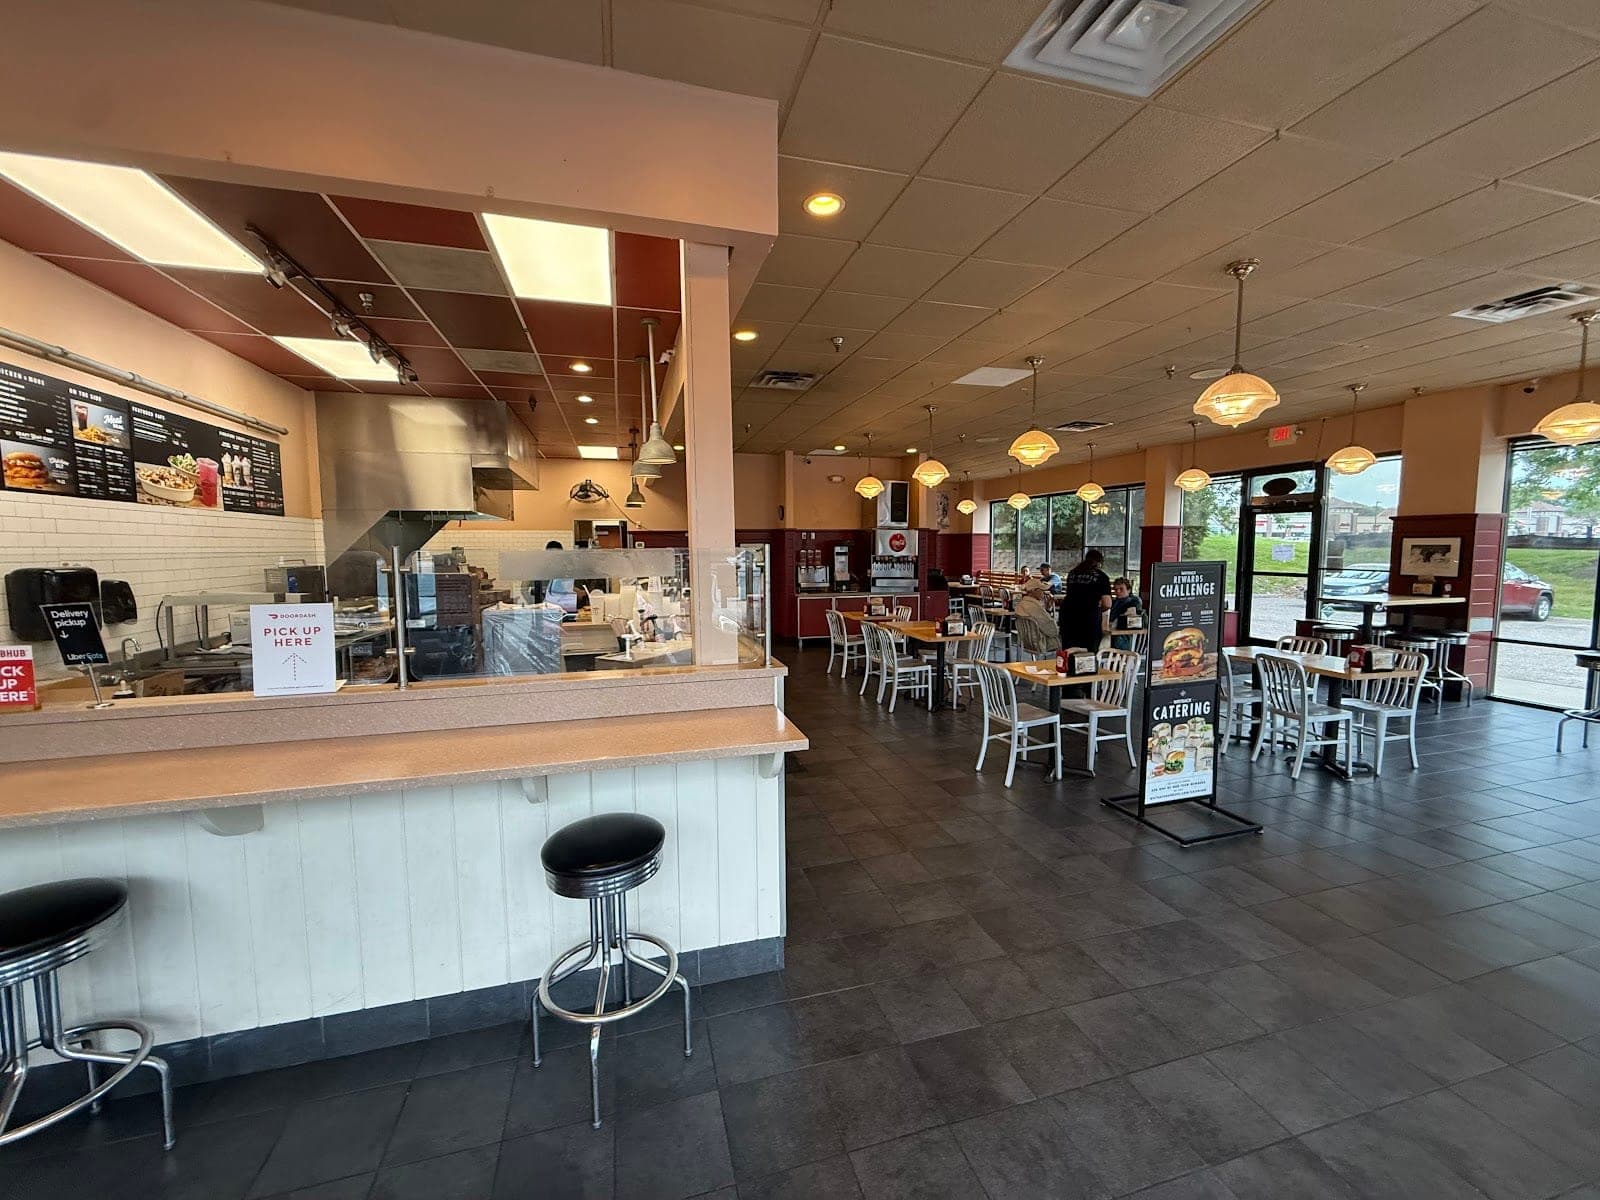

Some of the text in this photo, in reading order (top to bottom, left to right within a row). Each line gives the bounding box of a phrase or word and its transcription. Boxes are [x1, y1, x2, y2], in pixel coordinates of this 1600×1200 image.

[1173, 575, 1203, 584] REWARDS
[1160, 582, 1215, 597] CHALLENGE
[50, 610, 89, 619] Delivery
[54, 619, 87, 629] pickup
[264, 626, 321, 636] PICK UP
[274, 637, 312, 647] HERE
[66, 653, 86, 661] Uber
[1153, 701, 1210, 720] CATERING
